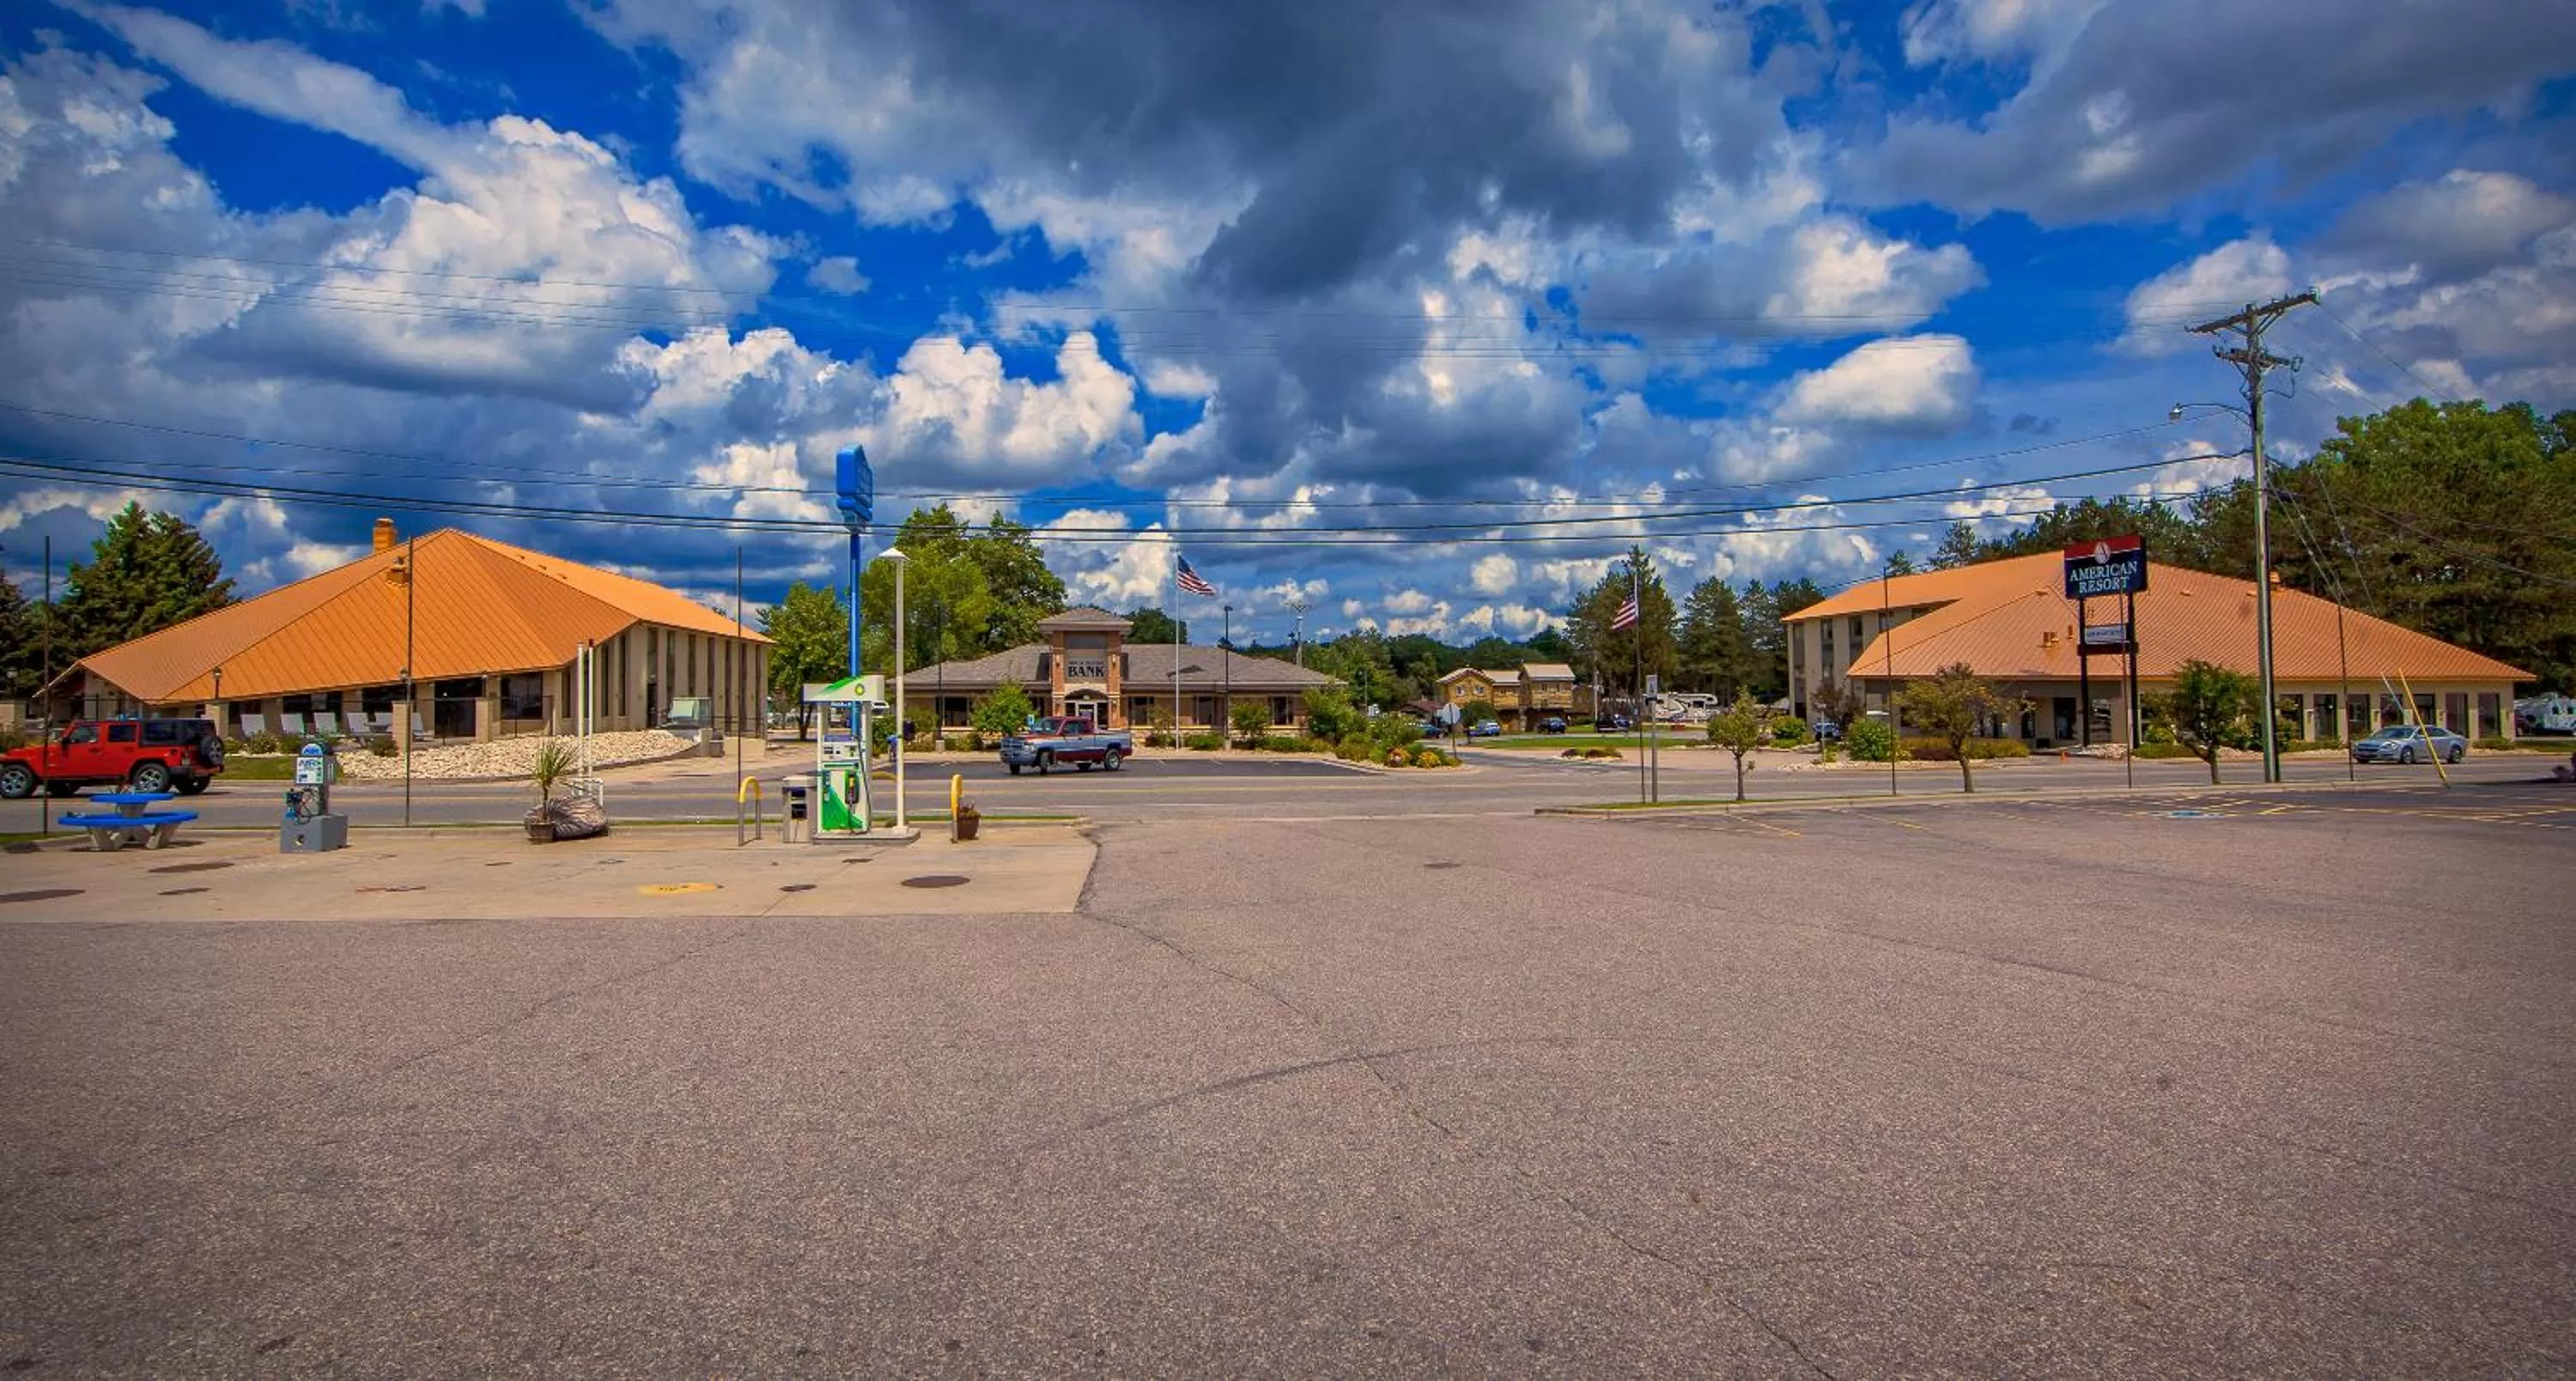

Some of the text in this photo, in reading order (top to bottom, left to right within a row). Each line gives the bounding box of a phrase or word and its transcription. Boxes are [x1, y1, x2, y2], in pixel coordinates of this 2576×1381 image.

[2070, 561, 2137, 581] AMERICAN
[2079, 575, 2129, 593] RESORT
[1068, 666, 1105, 677] BANK
